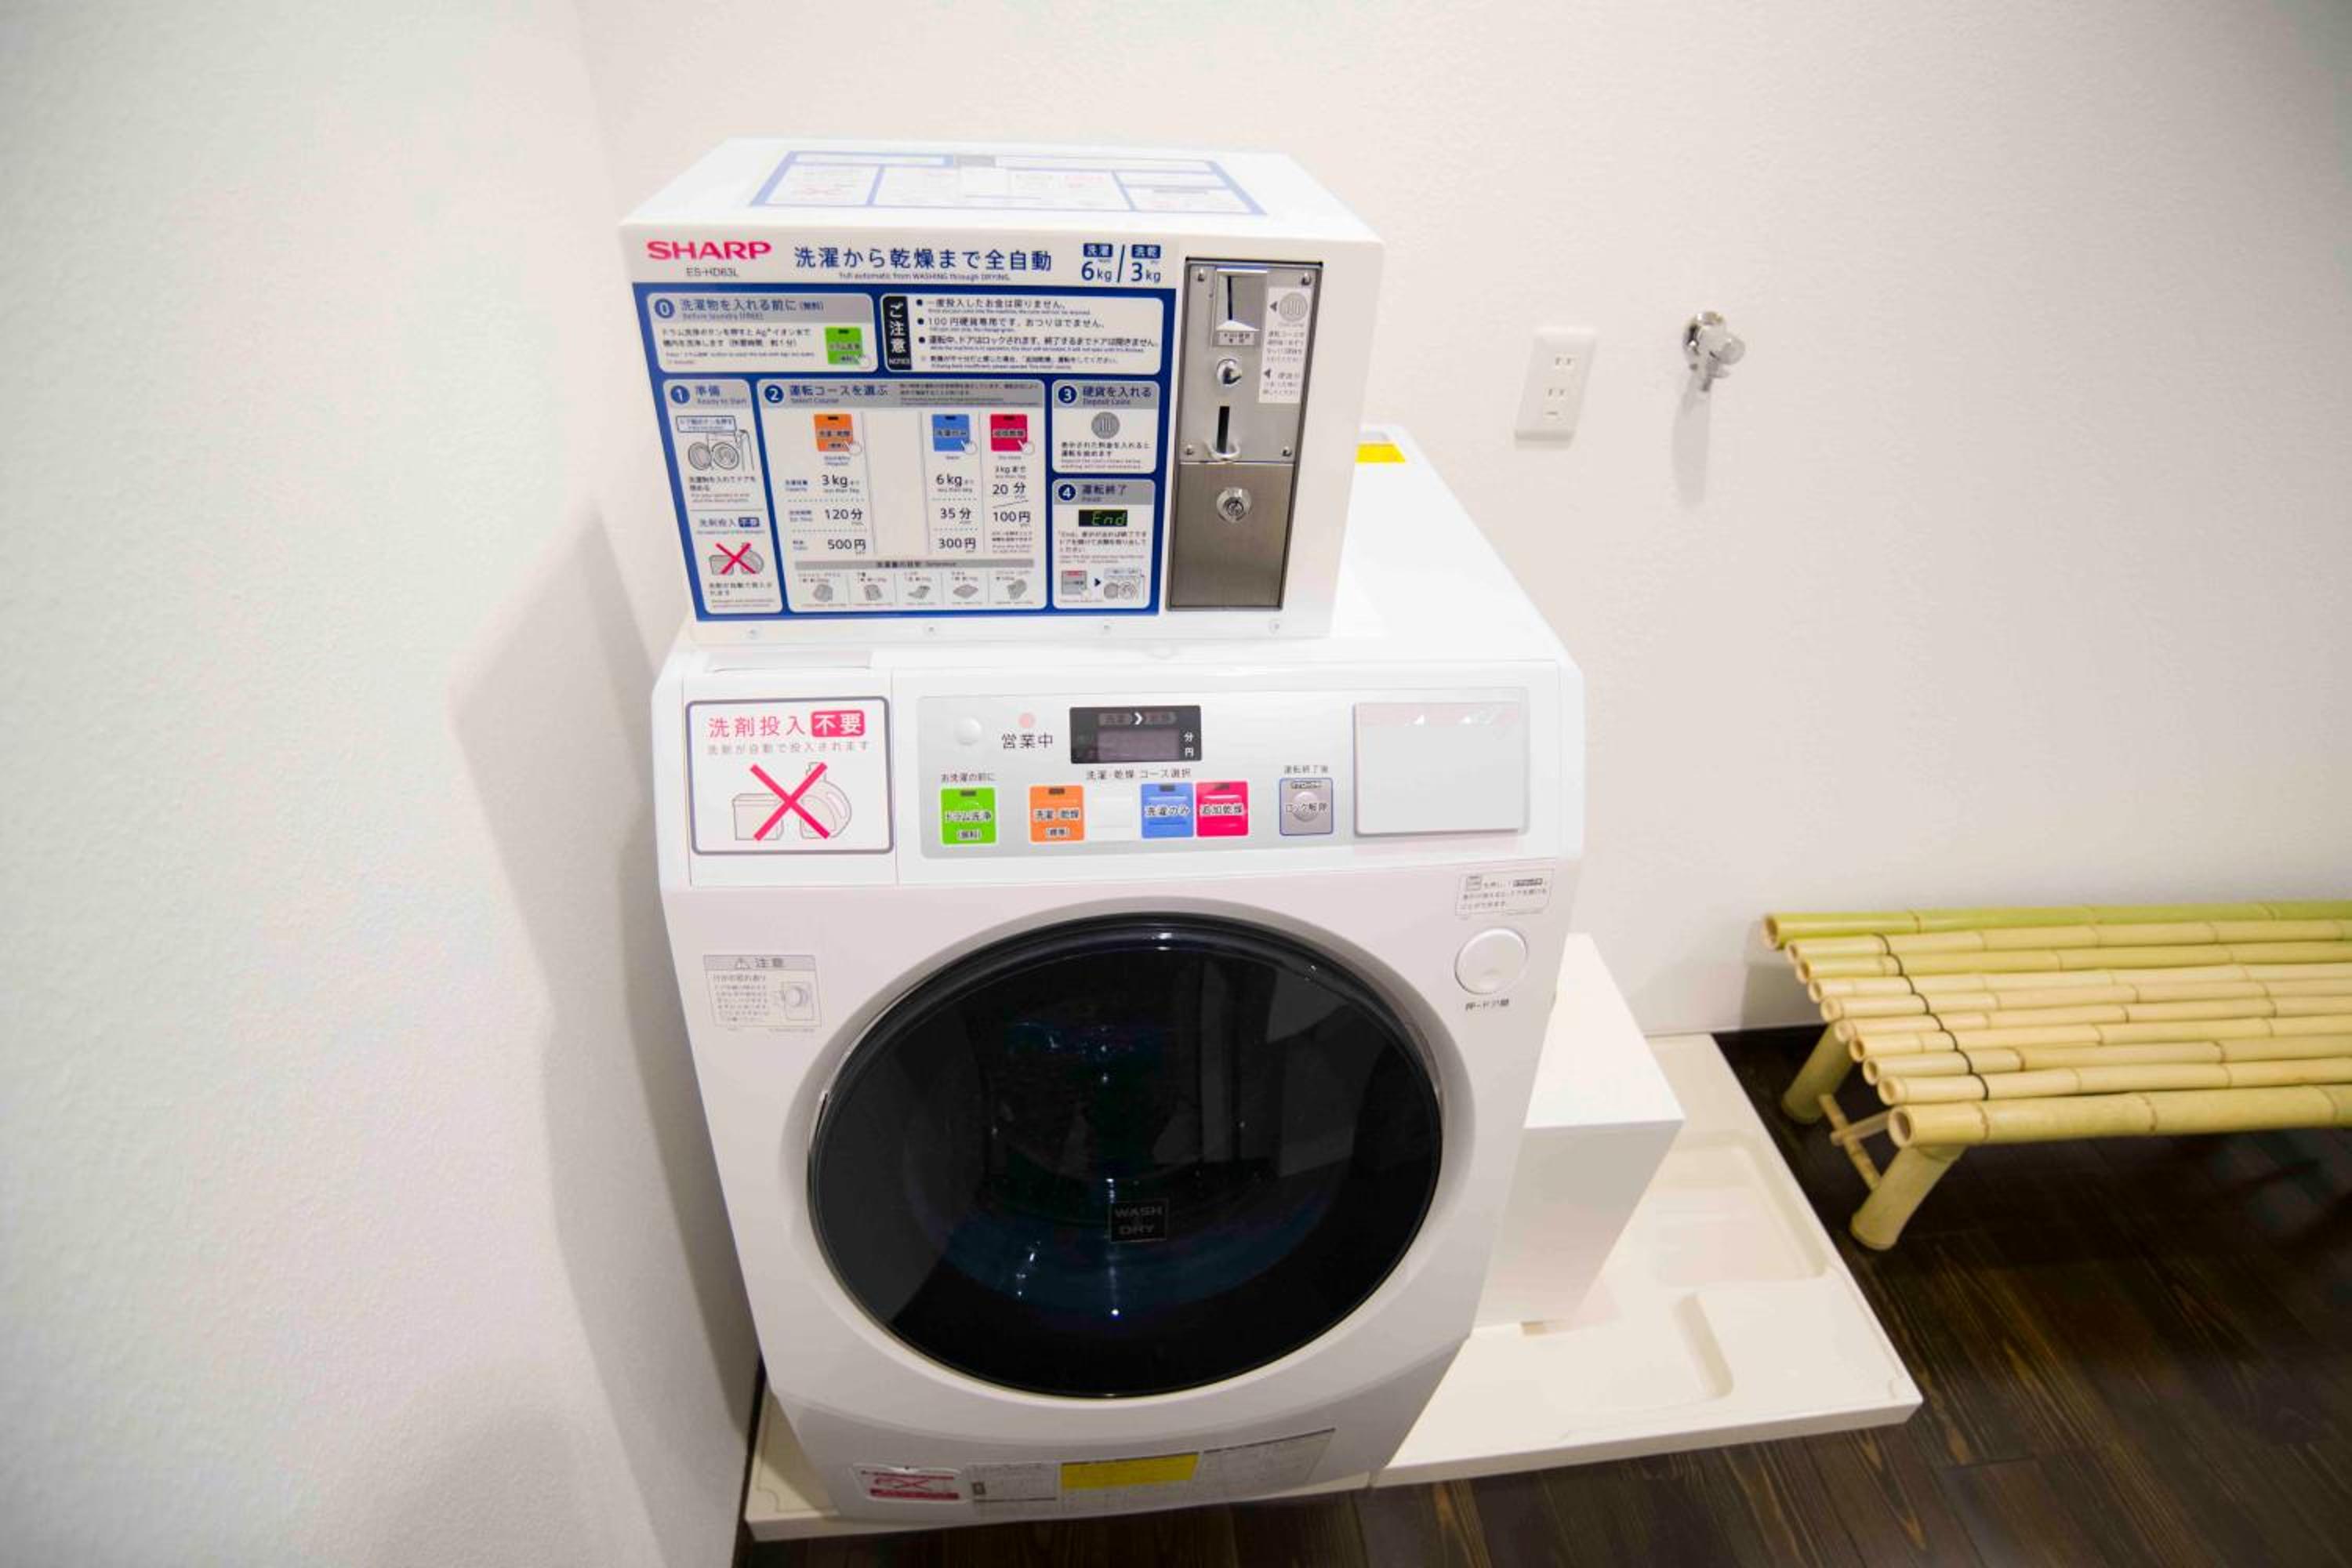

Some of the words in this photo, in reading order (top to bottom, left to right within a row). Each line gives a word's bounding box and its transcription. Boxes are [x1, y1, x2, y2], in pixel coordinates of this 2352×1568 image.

[646, 241, 772, 260] SHARP
[794, 246, 1052, 271] 洗濯から乾燥まで全自動
[680, 299, 797, 312] 洗濯物を入れる前に
[890, 302, 908, 353] ご注意
[789, 384, 888, 396] 運転コースを選ぶ
[1082, 386, 1152, 398] 硬貨を入れる
[1081, 484, 1128, 495] 運転終了
[824, 508, 863, 521] 120分
[940, 507, 971, 520] 35分
[993, 511, 1032, 523] 100円
[1091, 510, 1127, 527] End
[827, 539, 866, 550] 500円
[938, 537, 977, 549] 300円
[708, 716, 806, 738] 洗剤投入
[815, 713, 862, 735] 不要
[1001, 733, 1054, 750] 営業中
[1184, 731, 1194, 743] 分
[707, 741, 869, 756] 洗剤が自動で投入されます
[1185, 746, 1194, 758] 円
[1145, 804, 1191, 817] 洗濯のみ
[1200, 803, 1244, 816] 追加乾燥
[1285, 801, 1328, 814] ロック解除
[1115, 1206, 1163, 1218] WASH
